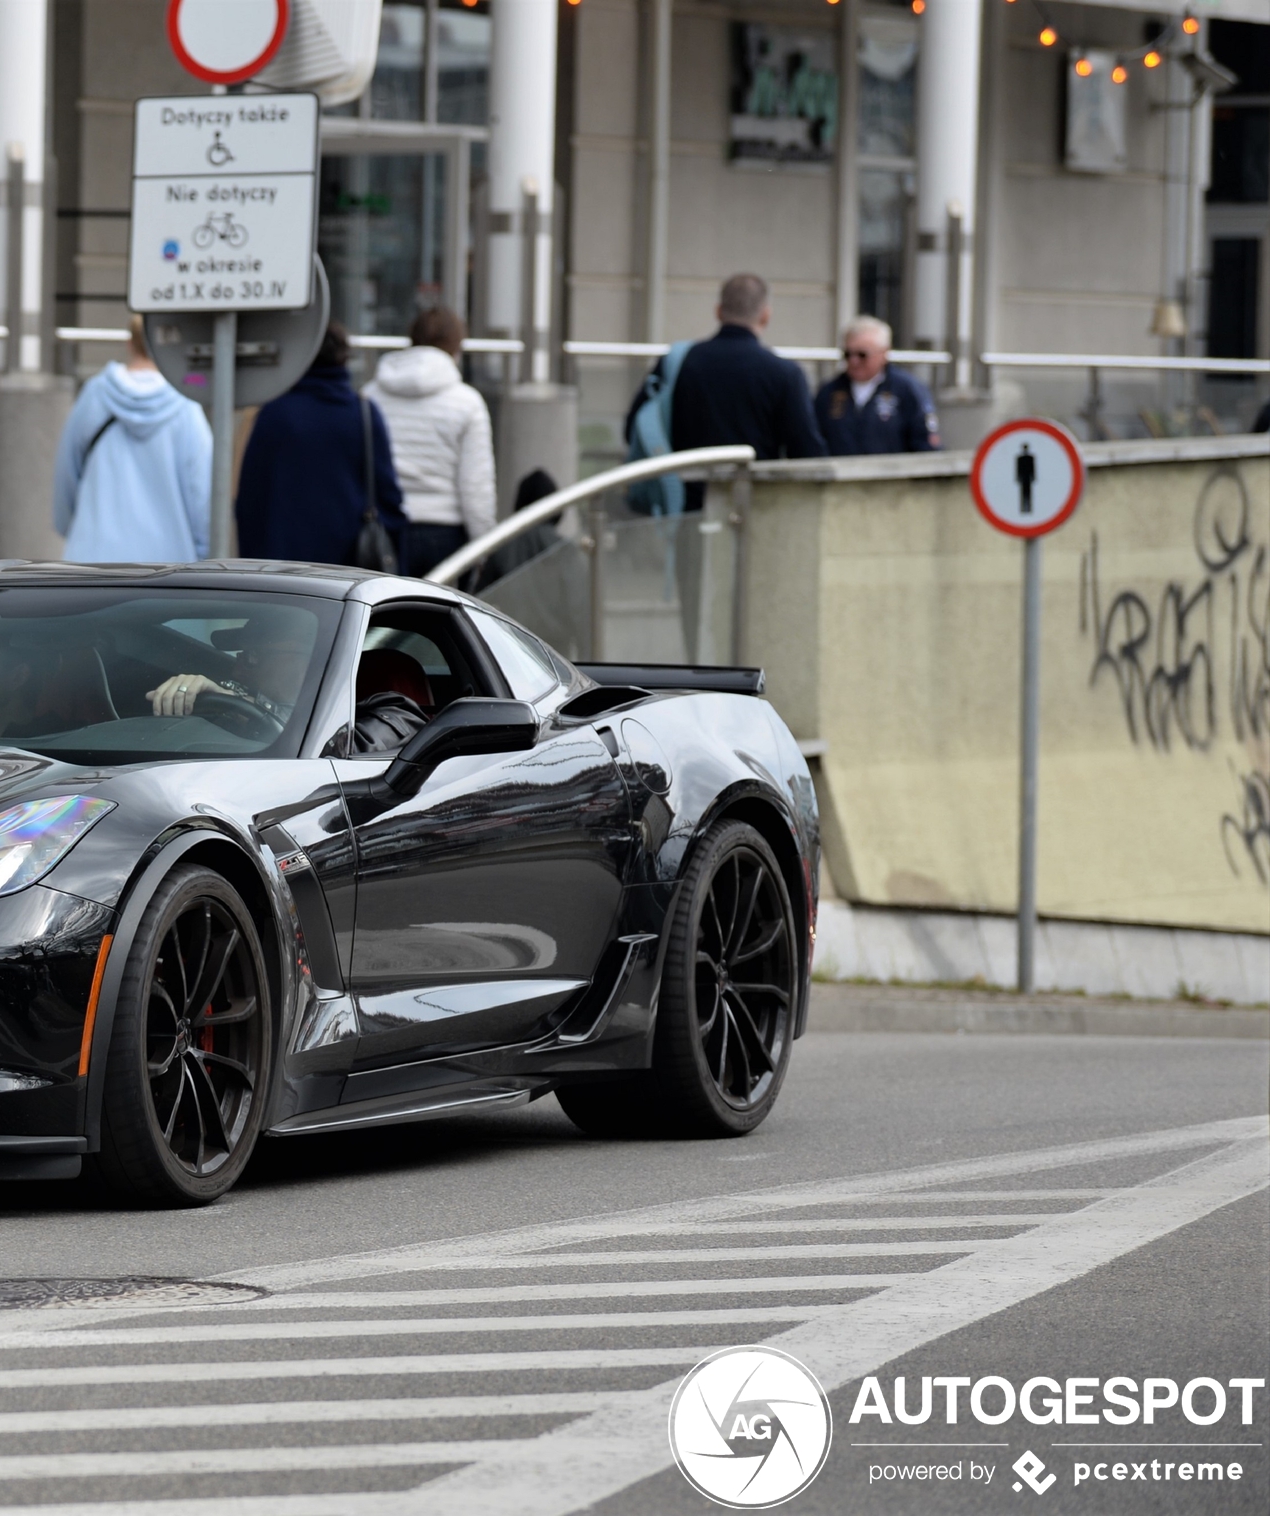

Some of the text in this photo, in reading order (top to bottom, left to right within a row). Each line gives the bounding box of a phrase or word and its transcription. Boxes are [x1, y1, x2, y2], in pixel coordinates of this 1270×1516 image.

[161, 104, 289, 128] Dotyczy także
[166, 185, 277, 205] Nie dotyczy
[176, 256, 263, 273] w okresie
[151, 280, 287, 300] od 1.X do 30.IV
